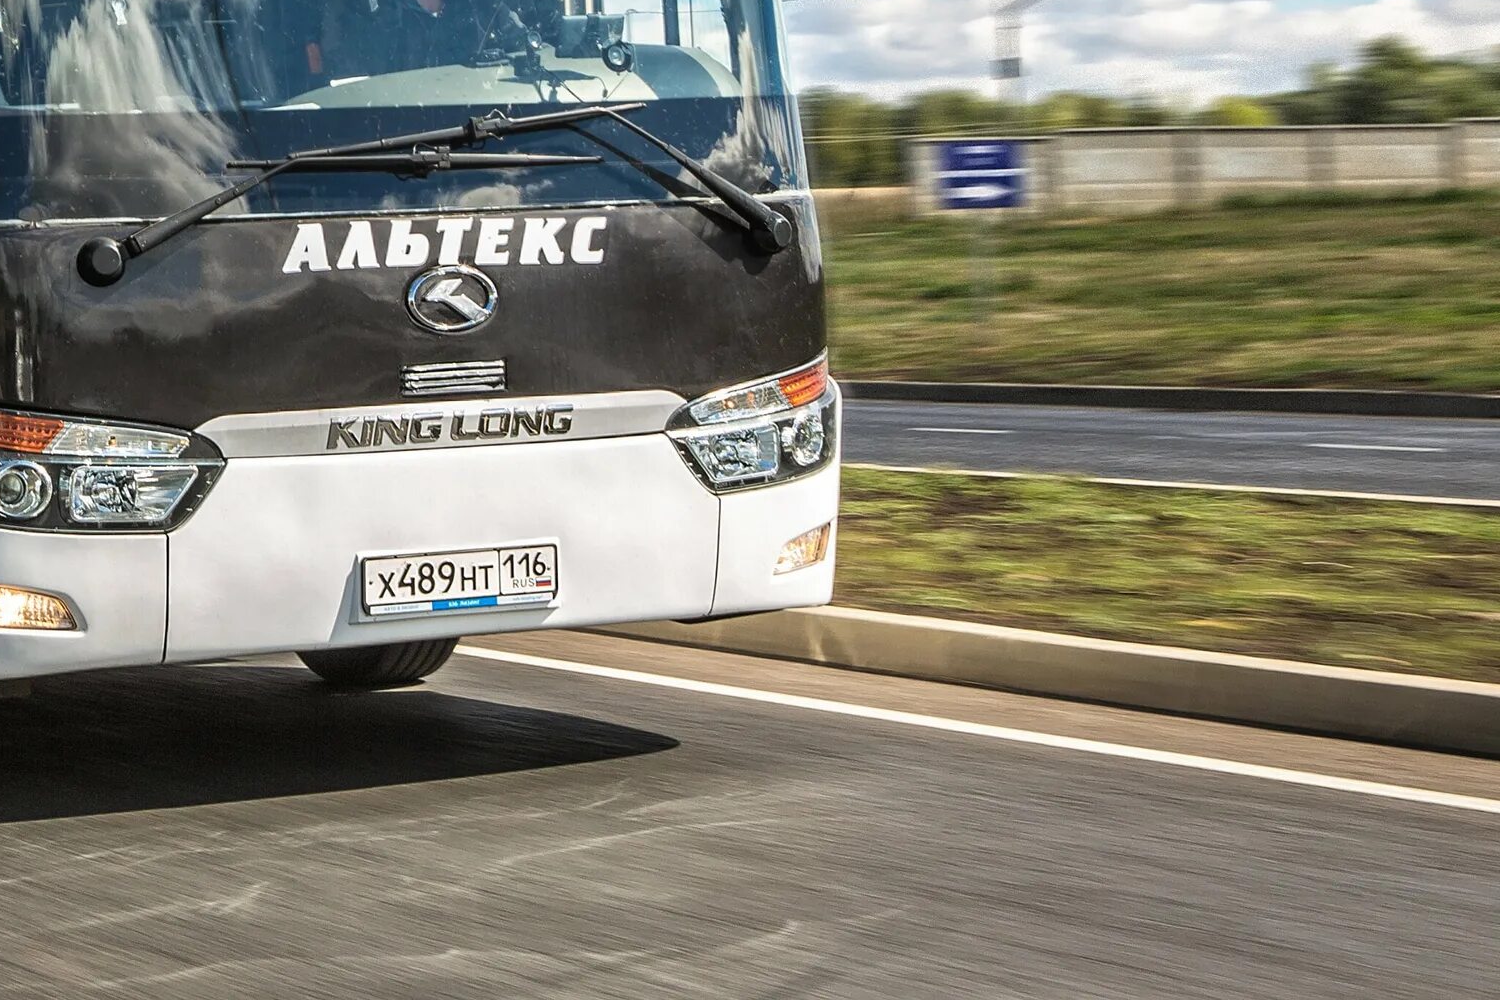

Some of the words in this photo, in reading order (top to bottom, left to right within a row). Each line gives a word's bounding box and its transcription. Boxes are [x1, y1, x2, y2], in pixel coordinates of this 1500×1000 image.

[282, 216, 607, 274] АЛЬТЕКС
[326, 411, 443, 450] KING
[450, 403, 574, 441] LONG
[502, 551, 546, 578] 116
[512, 577, 535, 588] RUS
